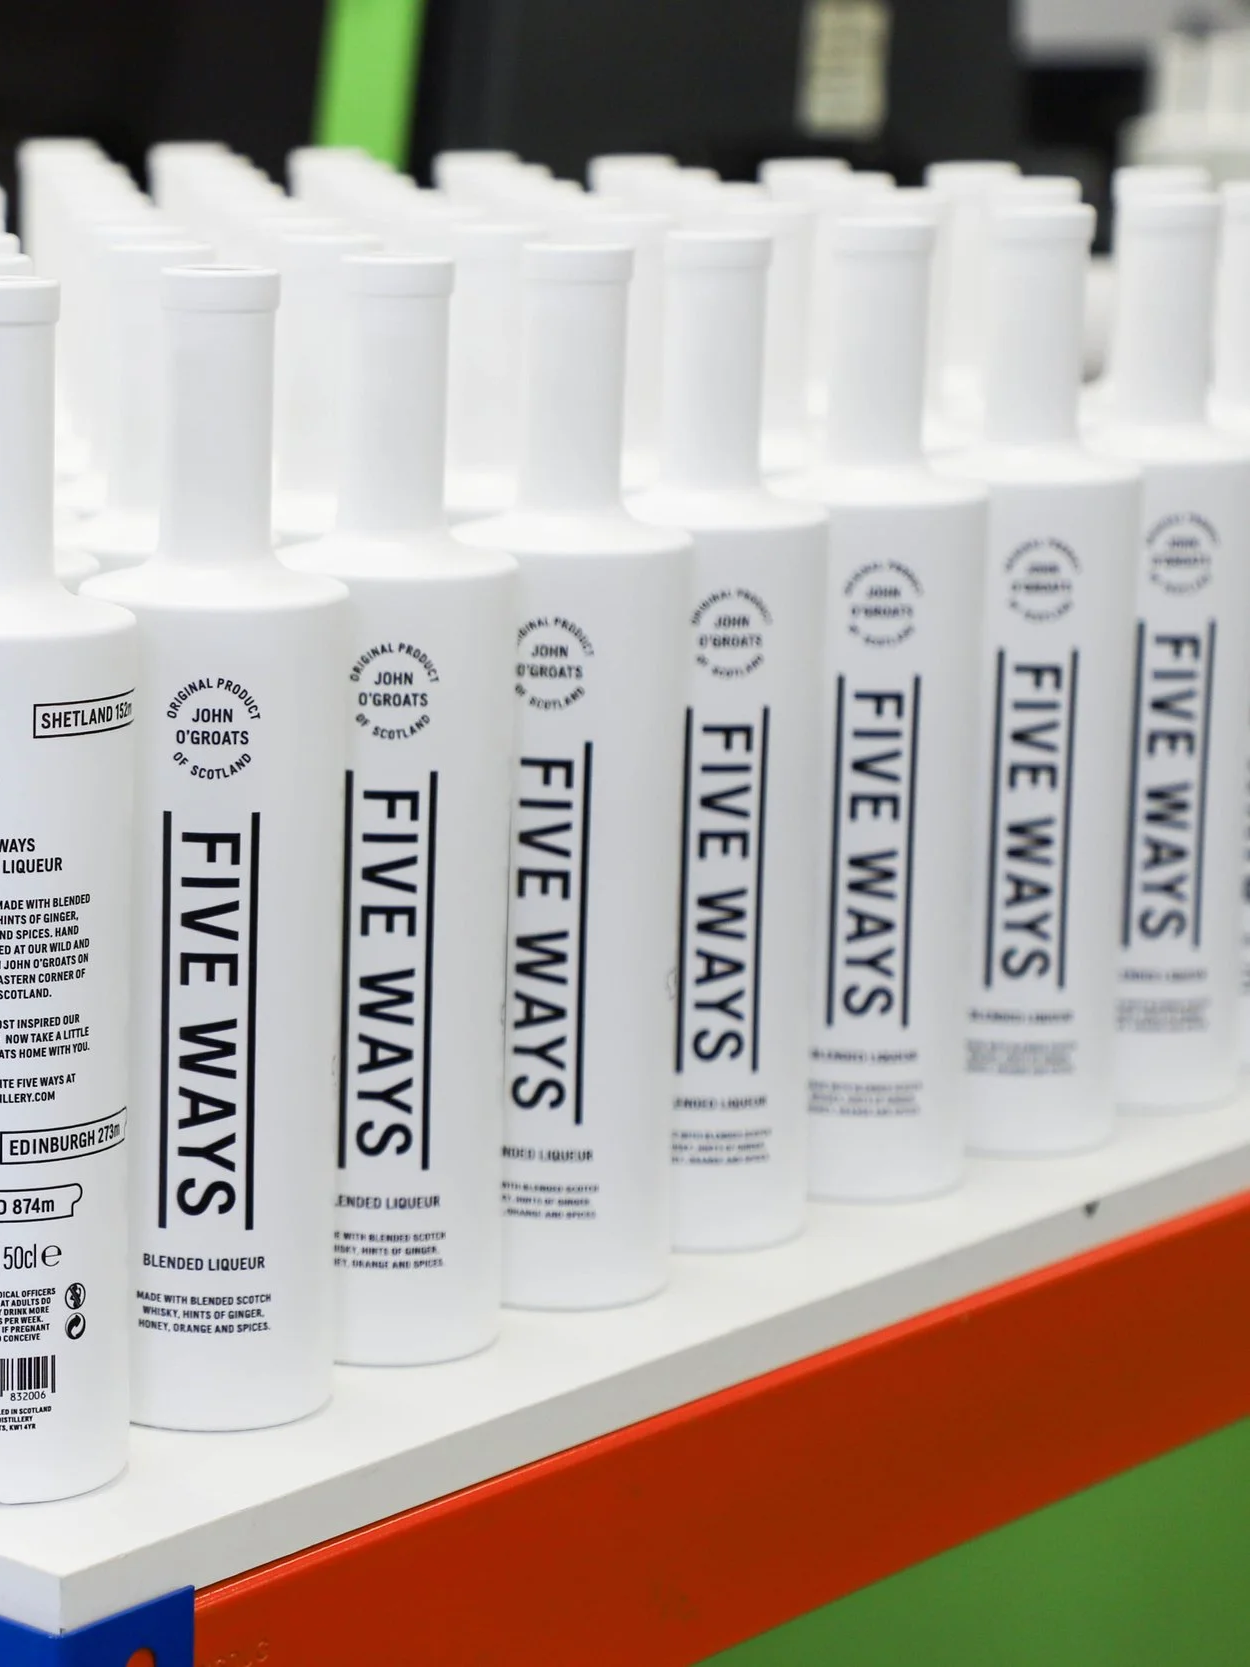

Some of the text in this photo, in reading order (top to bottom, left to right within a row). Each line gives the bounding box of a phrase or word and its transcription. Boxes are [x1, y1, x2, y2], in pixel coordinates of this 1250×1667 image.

[531, 644, 569, 658] JOHN
[374, 671, 414, 686] JOHN
[166, 677, 261, 720] ORIGINAL PRODUCT
[358, 692, 428, 707] O'GROATS
[41, 705, 113, 729] SHETLAND
[191, 708, 233, 723] JOHN
[1006, 663, 1064, 792] FIVE
[176, 729, 249, 746] O'GROATS
[173, 751, 252, 780] OF SCOTLAND
[847, 690, 906, 823] FIVE
[697, 723, 755, 861] FIVE
[515, 756, 575, 901] FIVE
[2, 857, 63, 874] LIQUEUR
[25, 898, 51, 910] WITH
[52, 893, 91, 908] BLENDED
[999, 816, 1057, 980] WAYS
[29, 913, 42, 925] OF
[43, 910, 79, 924] GINGER,
[15, 928, 53, 940] SPICES.
[55, 925, 79, 937] HAND
[841, 848, 899, 1018] WAYS
[13, 944, 26, 955] AT
[27, 943, 48, 954] OUR
[49, 940, 72, 953] WILD
[73, 938, 90, 950] AND
[3, 959, 31, 970] JOHN
[33, 955, 77, 969] O'GROATS
[77, 952, 89, 964] ON
[38, 970, 74, 983] CORNER
[75, 968, 86, 979] OF
[355, 789, 420, 1157] FIVE WAYS
[691, 886, 749, 1063] WAYS
[17, 1016, 61, 1029] INSPIRED
[62, 1013, 80, 1025] OUR
[175, 831, 241, 1216] FIVE WAYS
[509, 929, 570, 1111] WAYS
[5, 1033, 29, 1044] NOW
[30, 1031, 54, 1043] TAKE
[55, 1031, 62, 1041] A
[63, 1026, 89, 1040] LITTLE
[19, 1047, 47, 1059] HOME
[48, 1044, 71, 1057] WITH
[72, 1041, 90, 1053] YOU.
[16, 1077, 38, 1088] FIVE
[39, 1075, 65, 1087] WAYS
[65, 1073, 76, 1084] AT
[9, 1123, 120, 1156] EDINBURGH 273m
[12, 1197, 55, 1215] 874m
[385, 1195, 440, 1210] LIQUEUR
[3, 1243, 37, 1270] 50cl
[143, 1252, 265, 1272] BLENDED LIQUEUR
[10, 1390, 46, 1402] 832006
